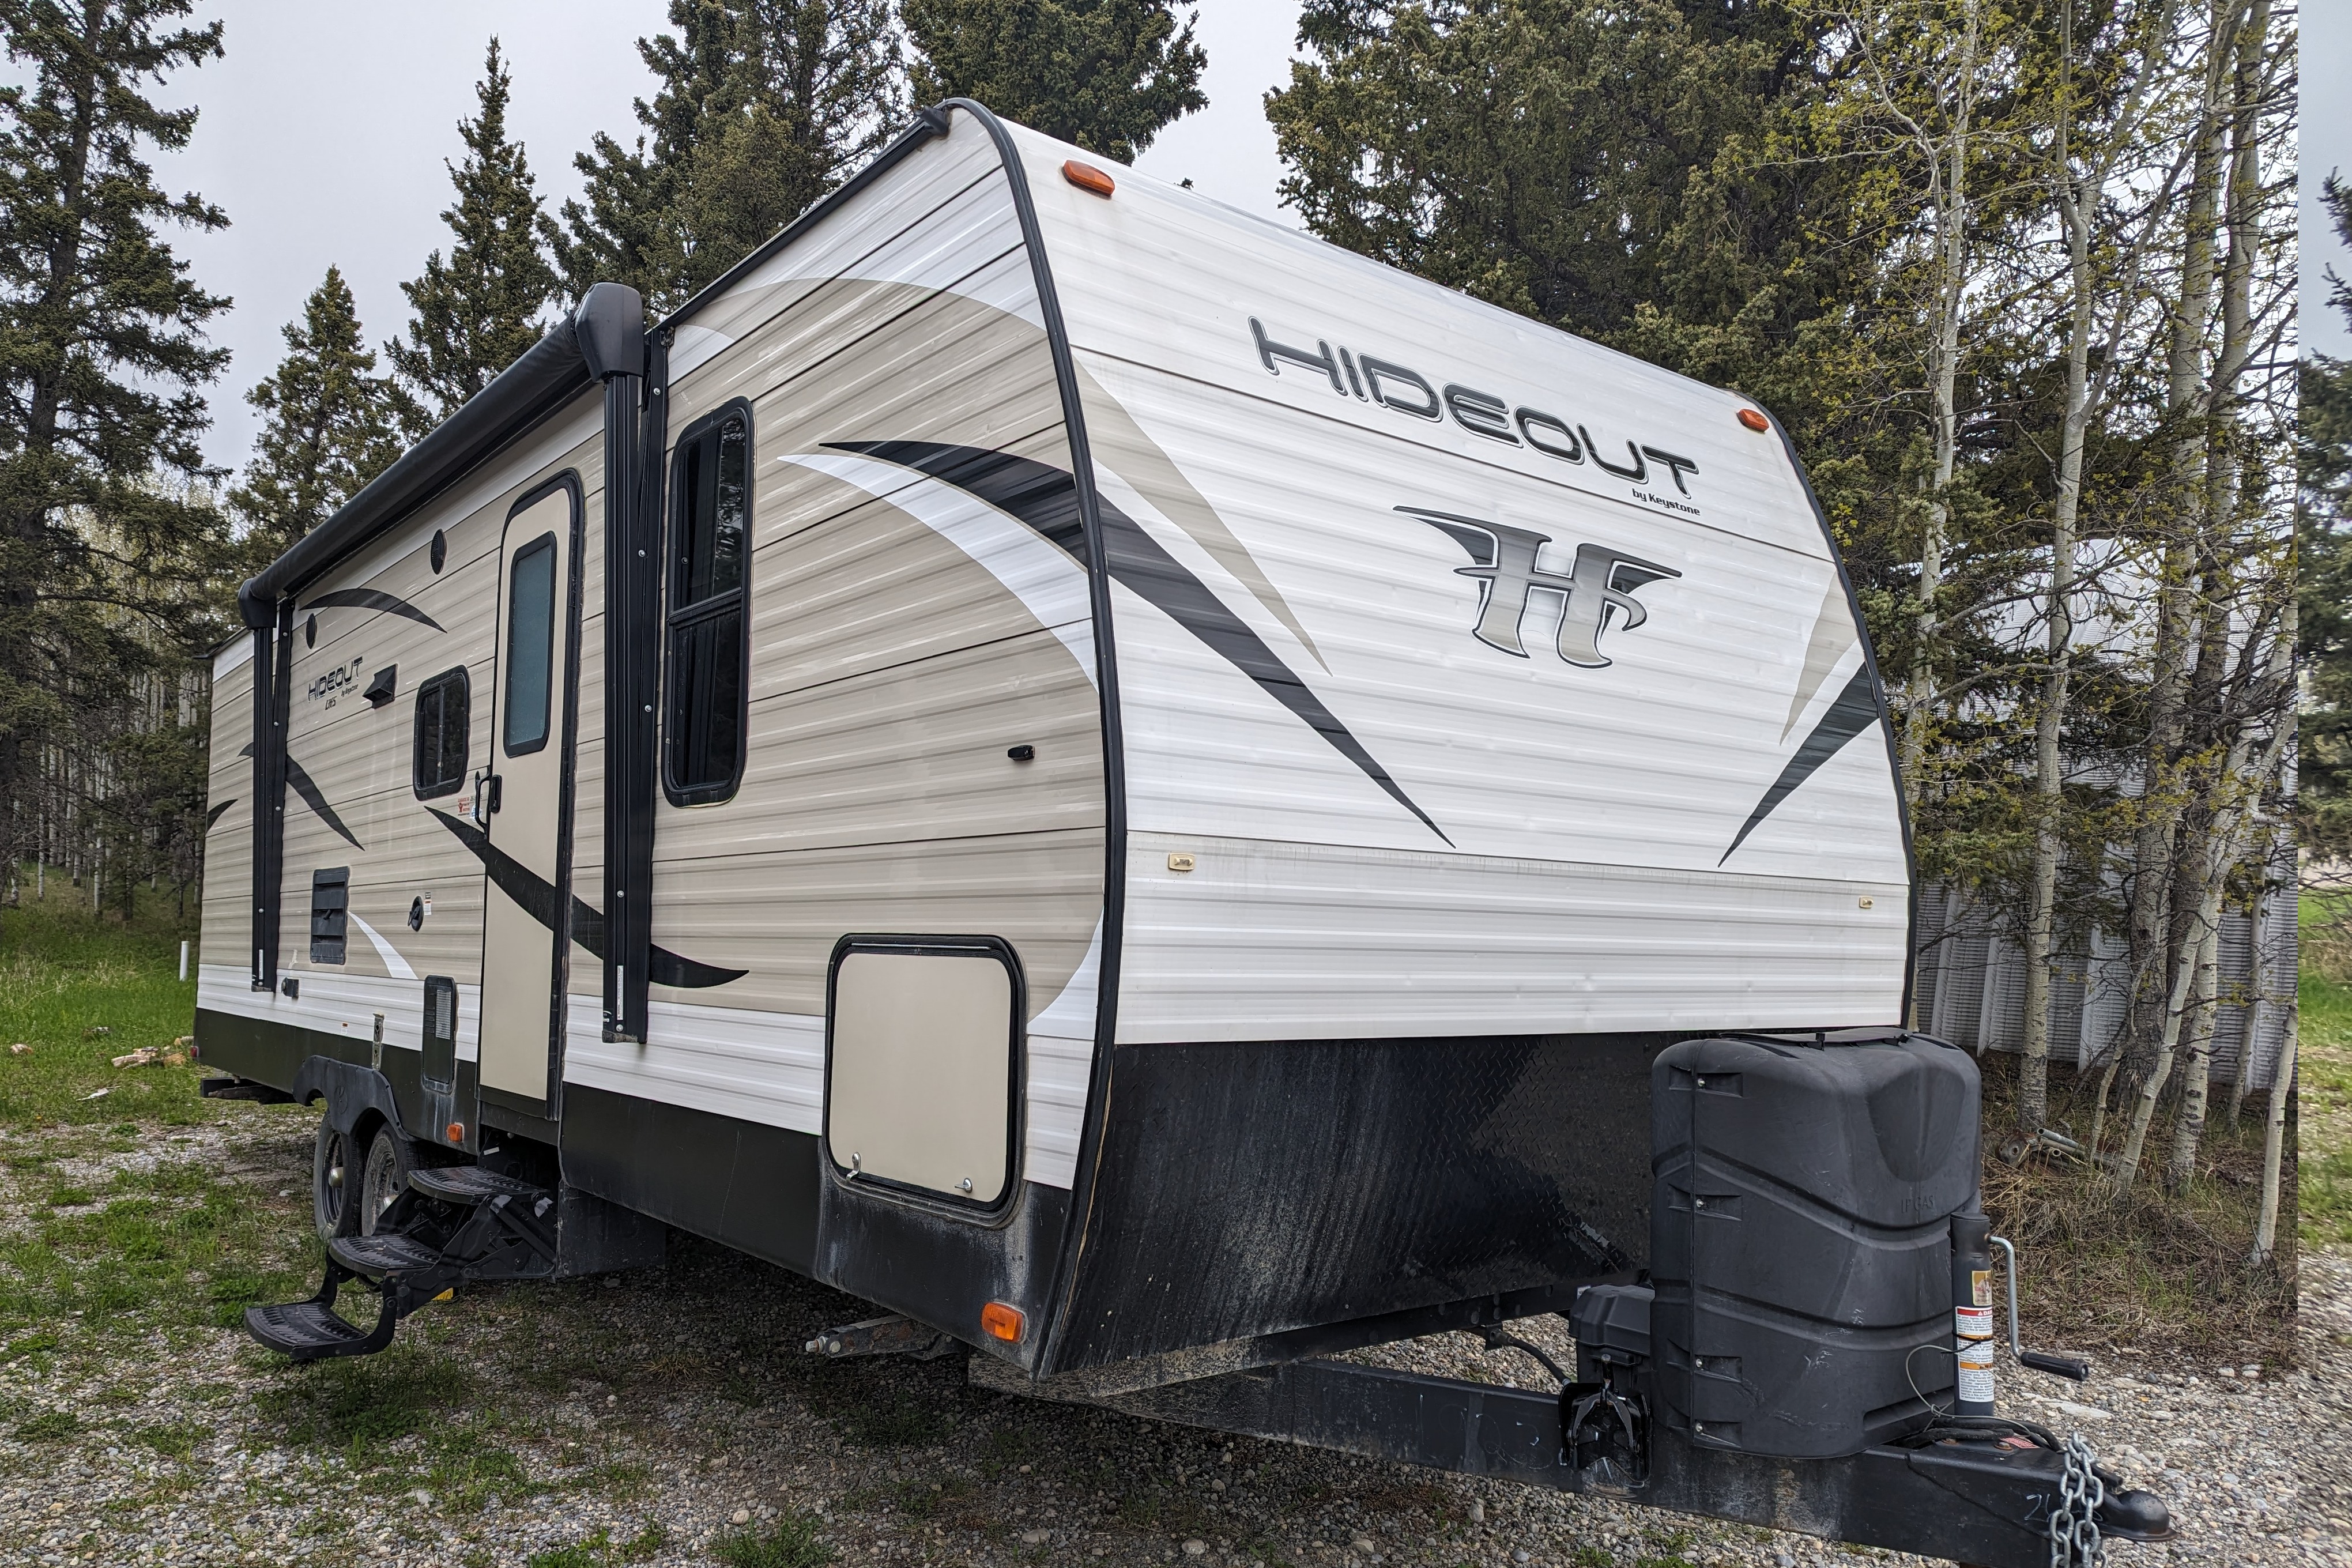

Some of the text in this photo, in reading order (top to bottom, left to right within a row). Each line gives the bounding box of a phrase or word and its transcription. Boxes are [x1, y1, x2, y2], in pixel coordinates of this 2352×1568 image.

[1247, 316, 1700, 499] HIDEOUT
[1632, 488, 1701, 516] by Keystone
[308, 656, 363, 703] HIDEOUT
